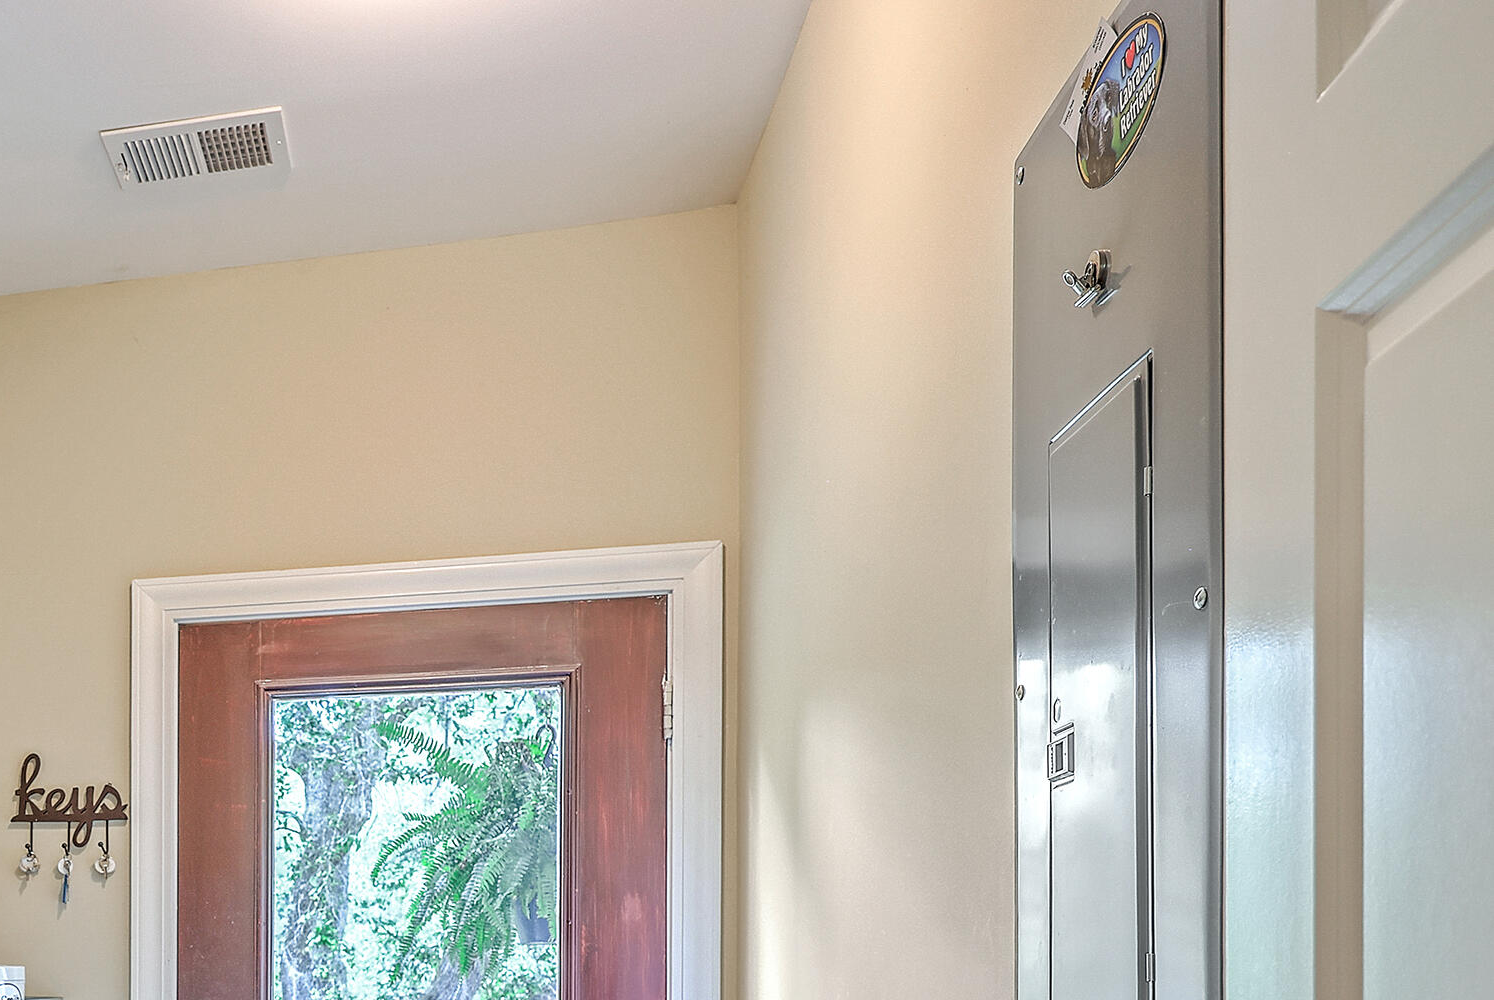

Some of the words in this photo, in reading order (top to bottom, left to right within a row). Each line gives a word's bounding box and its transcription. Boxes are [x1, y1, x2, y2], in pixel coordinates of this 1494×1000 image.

[1119, 43, 1154, 113] Labrador
[1120, 58, 1126, 78] I
[1135, 22, 1149, 54] My
[1120, 68, 1157, 139] Retriever
[13, 753, 128, 848] keys
